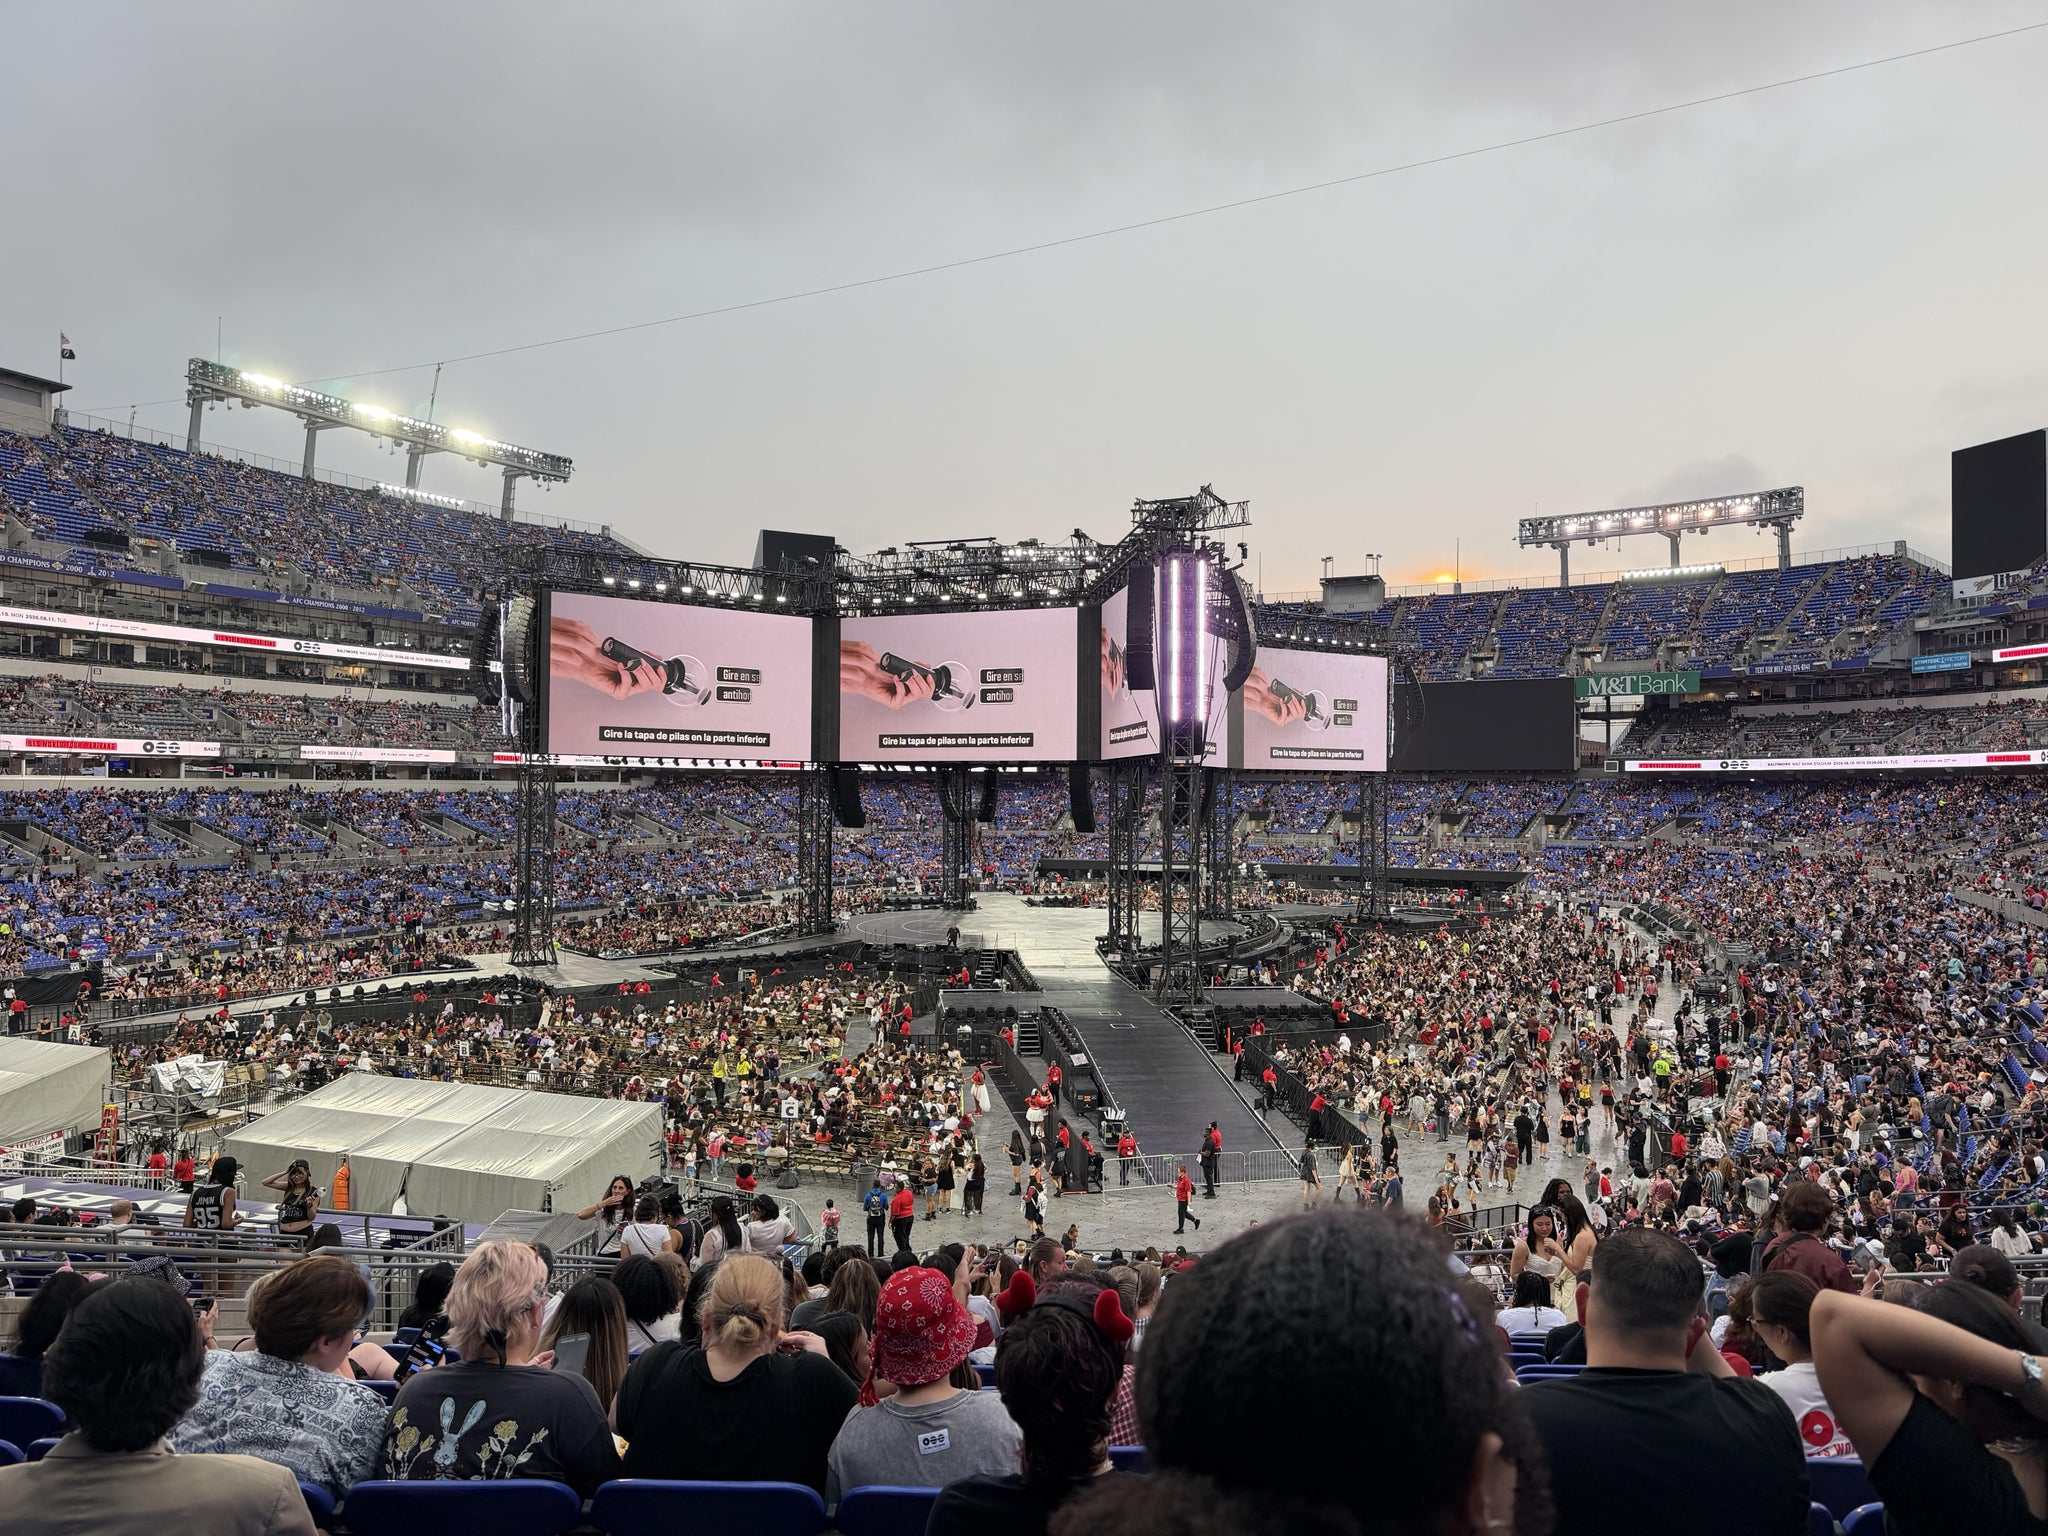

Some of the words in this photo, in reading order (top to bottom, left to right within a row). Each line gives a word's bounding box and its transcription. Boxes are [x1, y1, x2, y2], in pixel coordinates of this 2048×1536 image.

[7, 557, 50, 568] CHAMPIONS
[65, 565, 83, 573] 2000
[292, 597, 303, 605] AFC
[304, 600, 335, 609] CHAMPIONS
[723, 669, 738, 681] Gire
[740, 673, 750, 681] en
[986, 671, 1001, 682] Gire
[1003, 673, 1012, 682] en
[1587, 676, 1637, 696] M&T
[1639, 674, 1687, 694] Bank
[603, 729, 623, 738] Gire
[624, 730, 633, 739] la
[634, 731, 654, 741] tapa
[656, 731, 668, 740] de
[669, 732, 690, 742] pilas
[704, 733, 712, 741] la
[713, 734, 736, 744] parte
[737, 734, 767, 744] inferior
[882, 737, 898, 745] Gire
[899, 737, 907, 745] la
[908, 738, 925, 747] tapa
[926, 736, 936, 745] de
[937, 736, 956, 746] pilas
[969, 736, 976, 745] la
[977, 737, 999, 746] parte
[1000, 735, 1031, 744] inferior
[70, 1030, 77, 1039] A
[461, 1046, 467, 1055] B
[785, 1106, 794, 1116] C
[196, 1196, 215, 1205] JIMIN
[194, 1207, 219, 1228] 95
